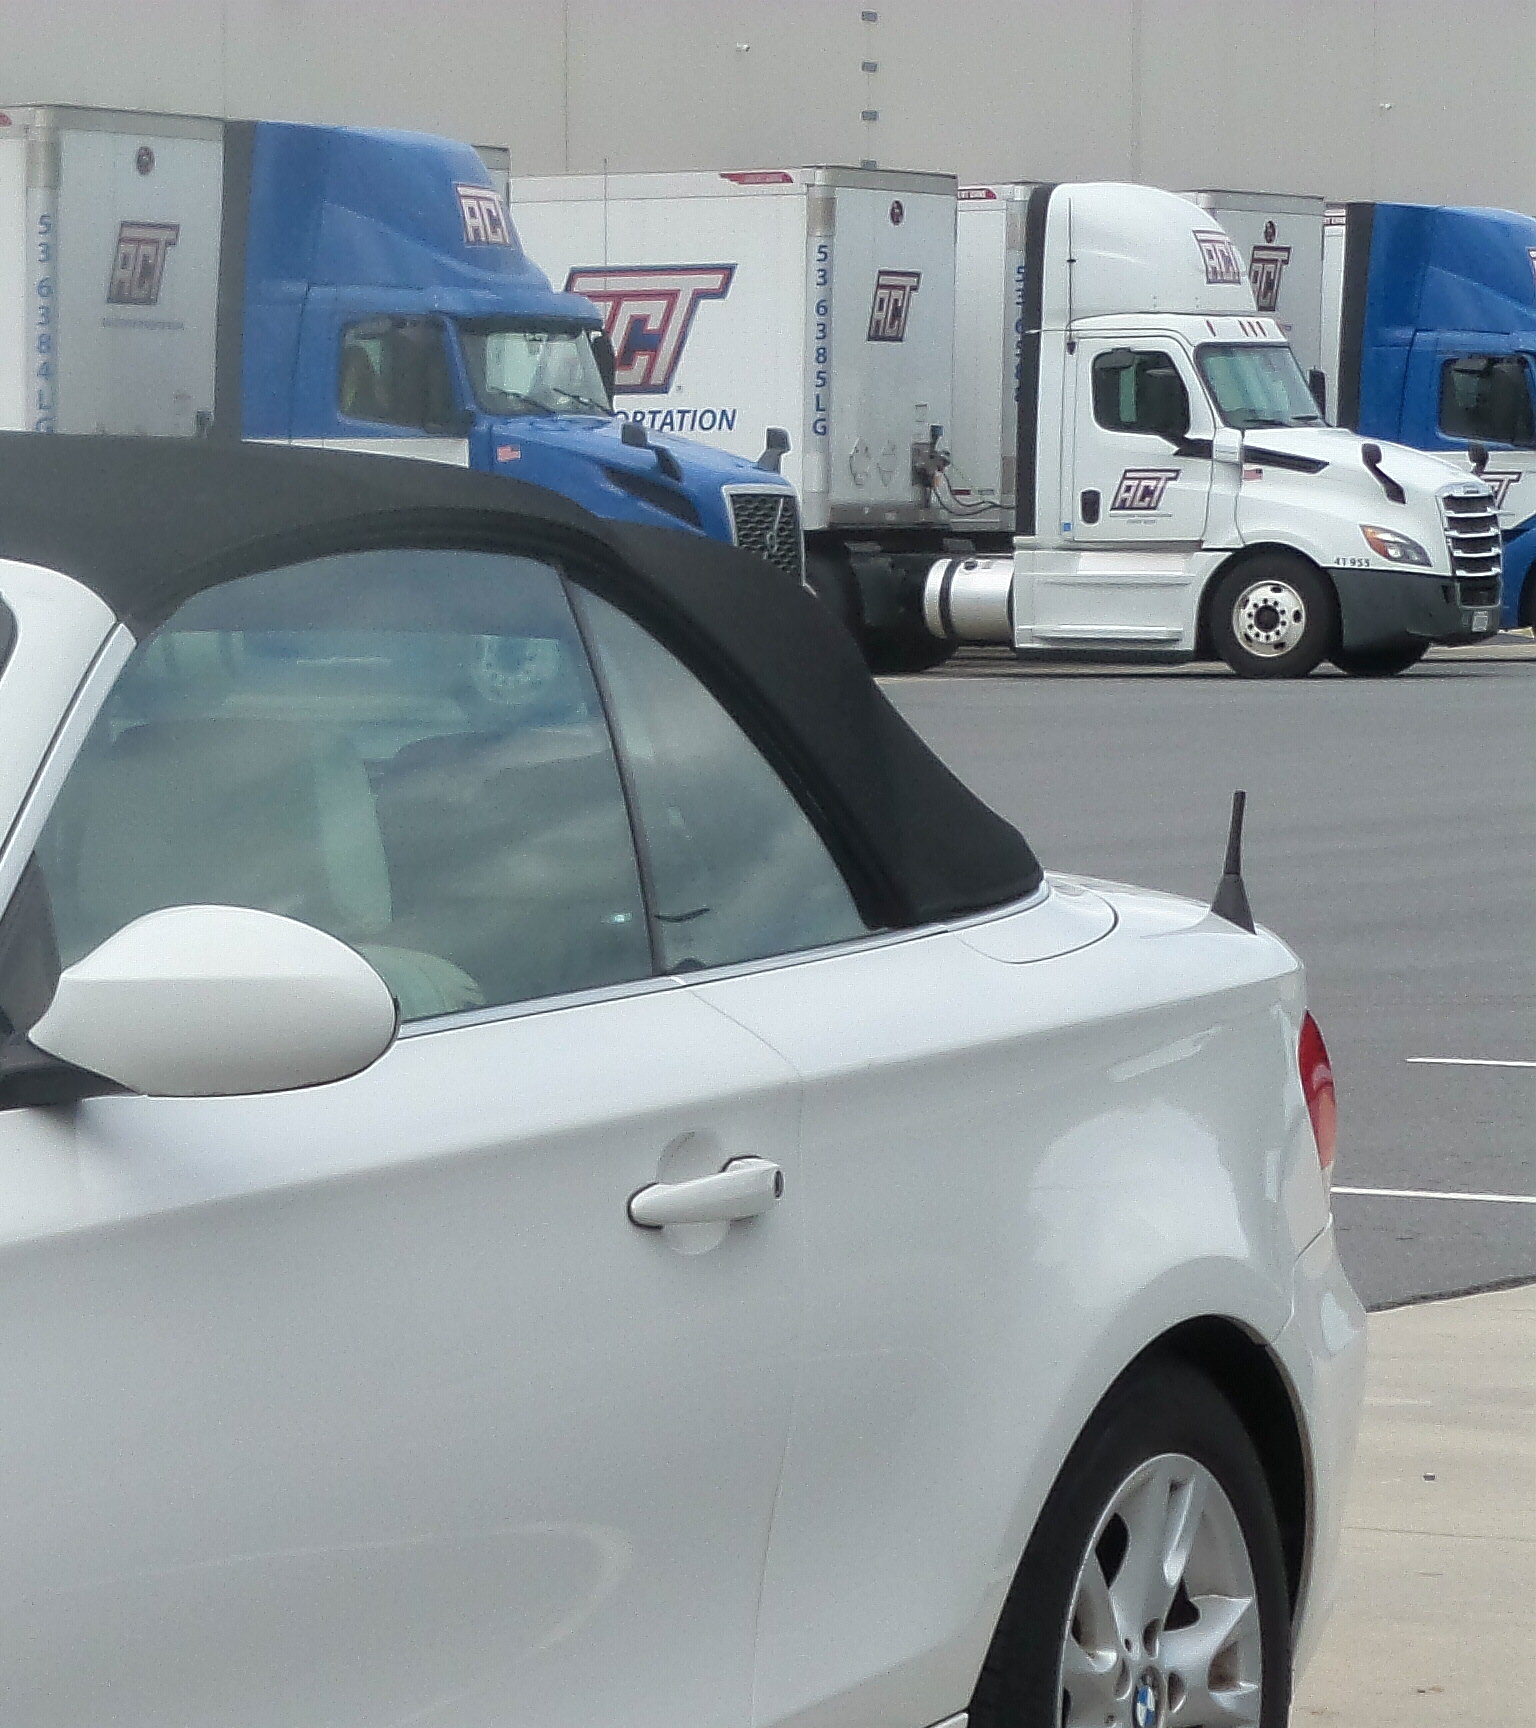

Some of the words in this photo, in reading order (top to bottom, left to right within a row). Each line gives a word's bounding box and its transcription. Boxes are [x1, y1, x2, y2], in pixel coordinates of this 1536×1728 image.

[455, 183, 512, 246] ACT
[107, 220, 180, 304] ACT
[1192, 230, 1241, 285] ACT
[564, 263, 738, 394] CT
[867, 270, 922, 342] ACT
[1110, 469, 1182, 511] ACT
